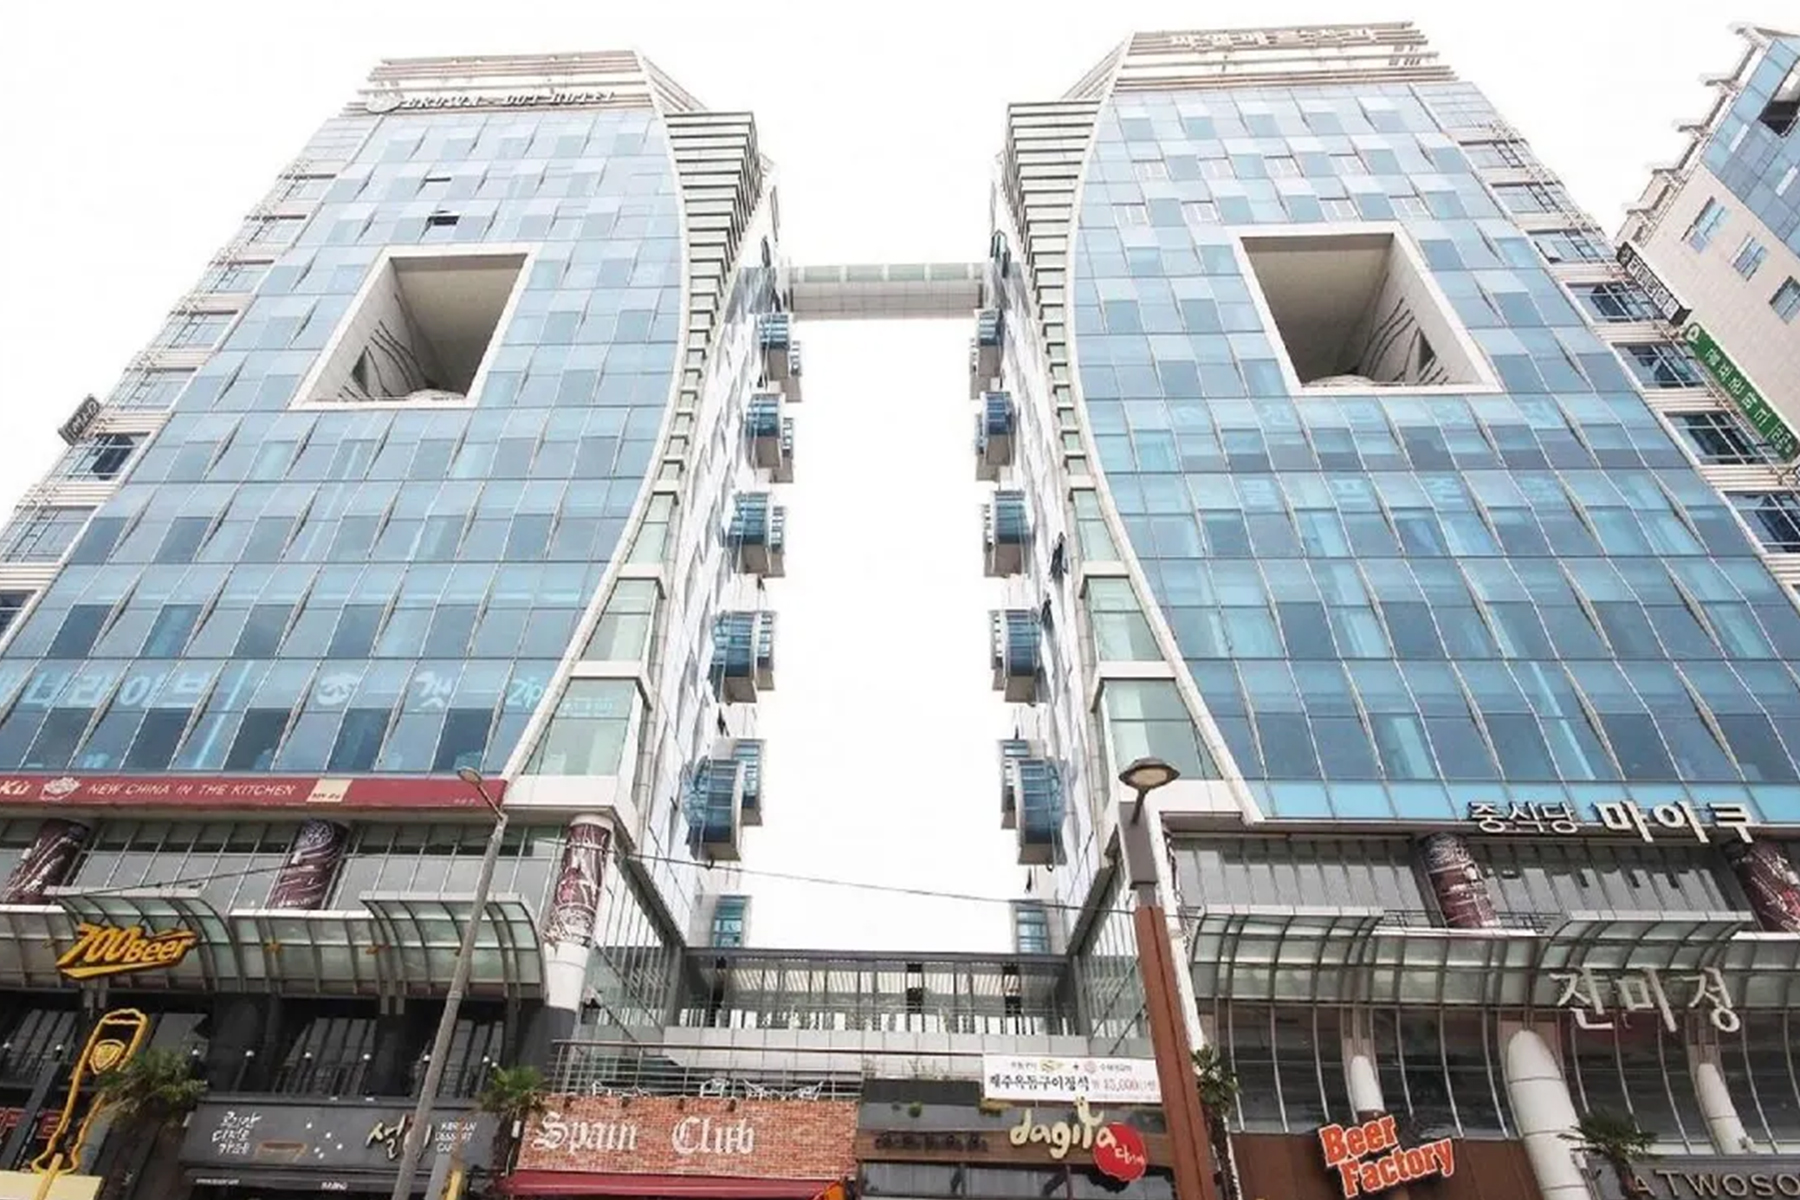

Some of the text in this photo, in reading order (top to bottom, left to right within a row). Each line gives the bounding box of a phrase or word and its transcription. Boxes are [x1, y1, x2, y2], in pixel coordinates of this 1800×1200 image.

[87, 784, 121, 795] NEW
[125, 784, 169, 795] CHINA
[175, 784, 193, 795] IN
[198, 784, 228, 795] THE
[231, 784, 296, 796] KITCHEN
[1470, 800, 1753, 844] 중식당 마이쿠
[531, 1111, 755, 1155] Spain Club
[1318, 1114, 1455, 1199] Beer Factory
